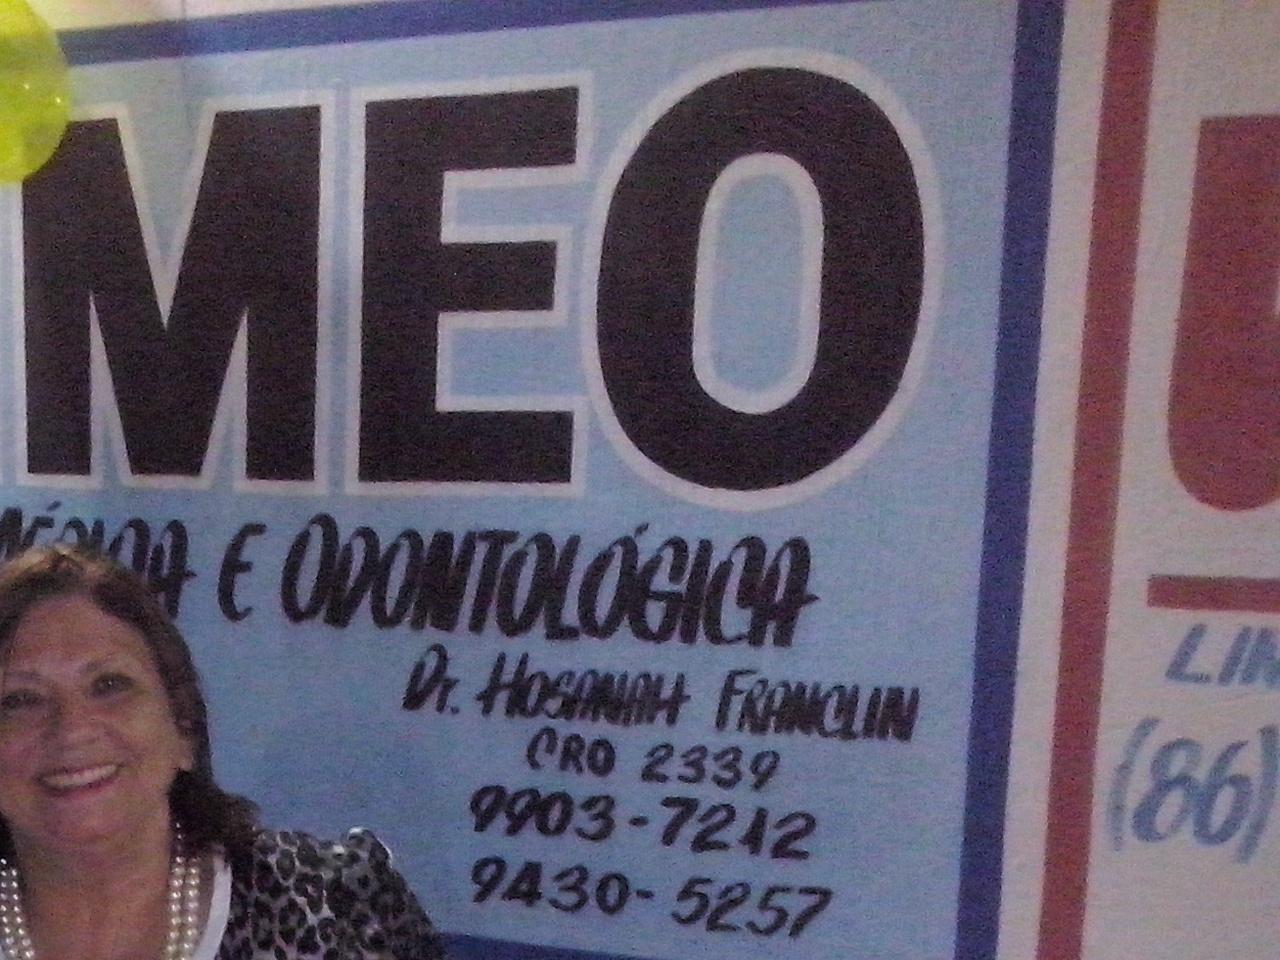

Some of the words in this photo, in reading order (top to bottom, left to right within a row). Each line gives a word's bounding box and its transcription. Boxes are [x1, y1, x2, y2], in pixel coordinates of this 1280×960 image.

[217, 522, 268, 623] E
[281, 512, 820, 648] ODONTOLÓGICA
[525, 726, 617, 778] CRO
[640, 743, 782, 793] 2339
